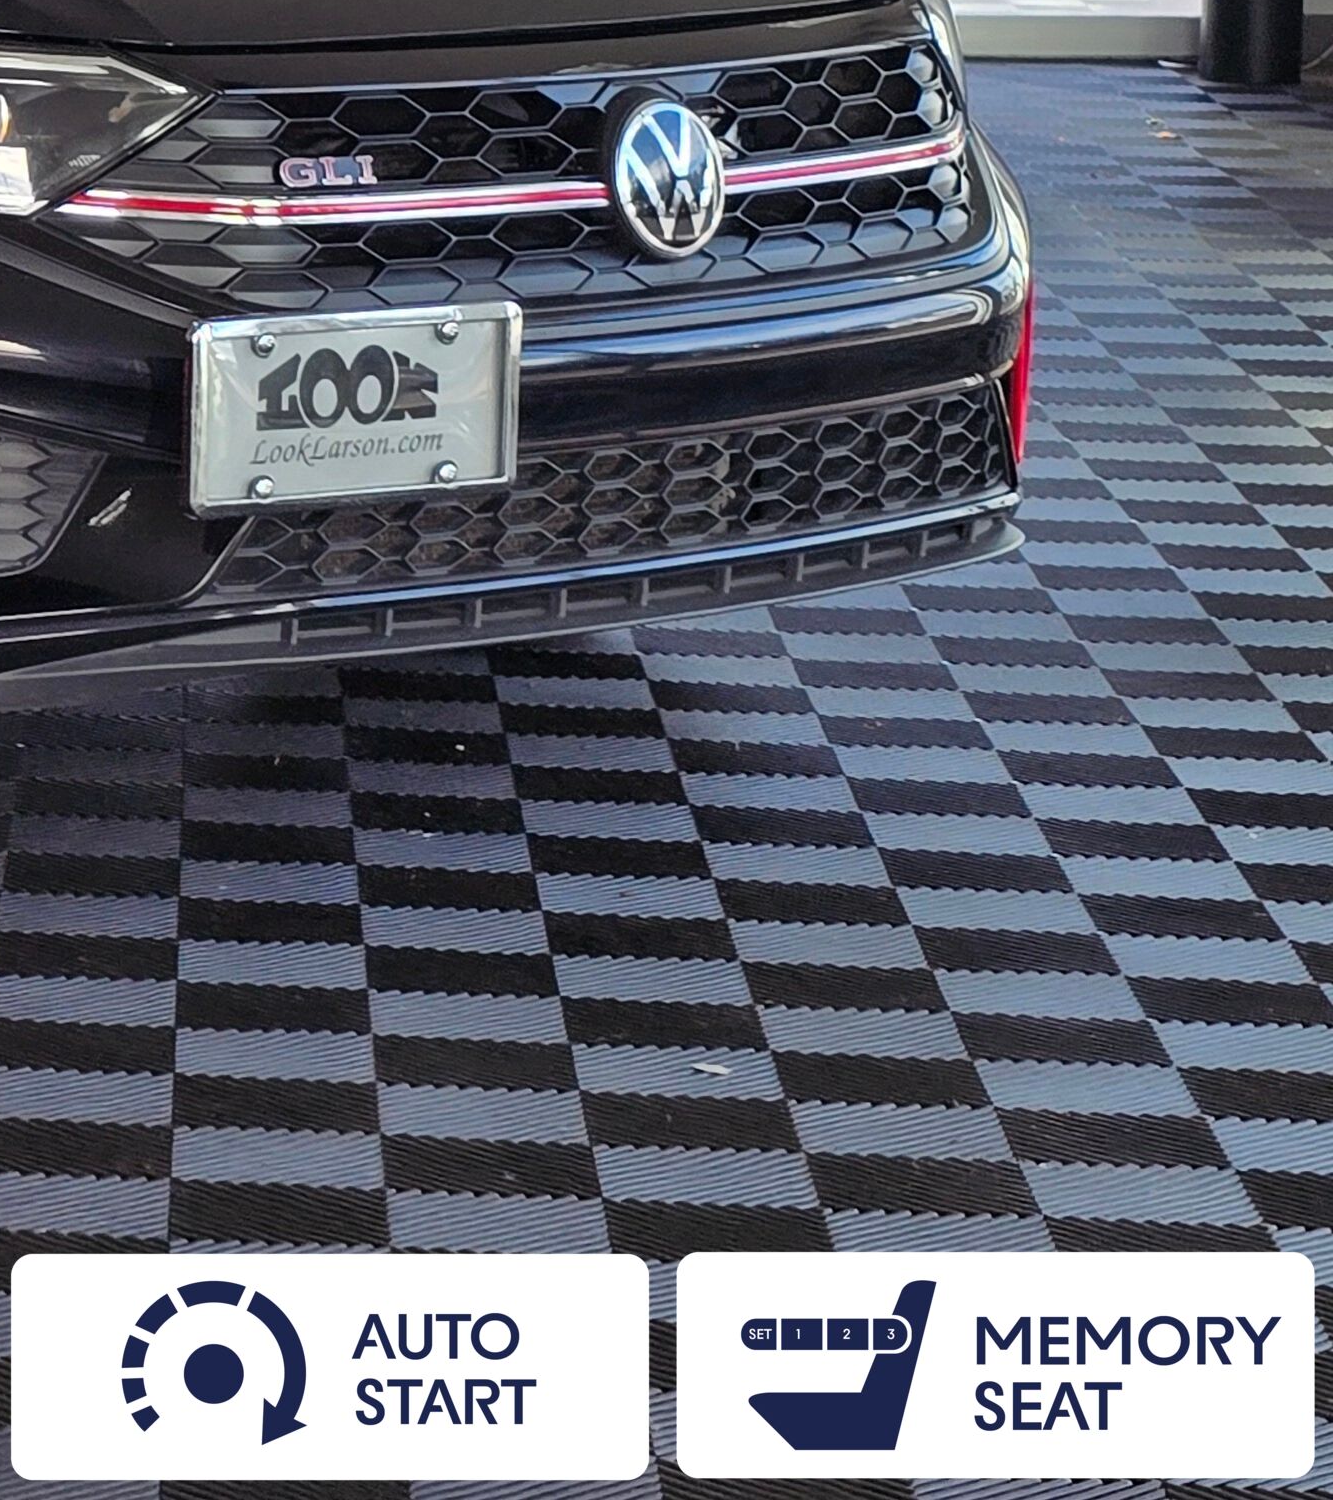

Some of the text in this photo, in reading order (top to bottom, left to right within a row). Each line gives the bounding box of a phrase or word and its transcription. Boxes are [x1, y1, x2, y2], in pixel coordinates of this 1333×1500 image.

[279, 154, 378, 188] GLI
[256, 345, 439, 431] LOOK
[250, 431, 444, 467] LookLarson.com
